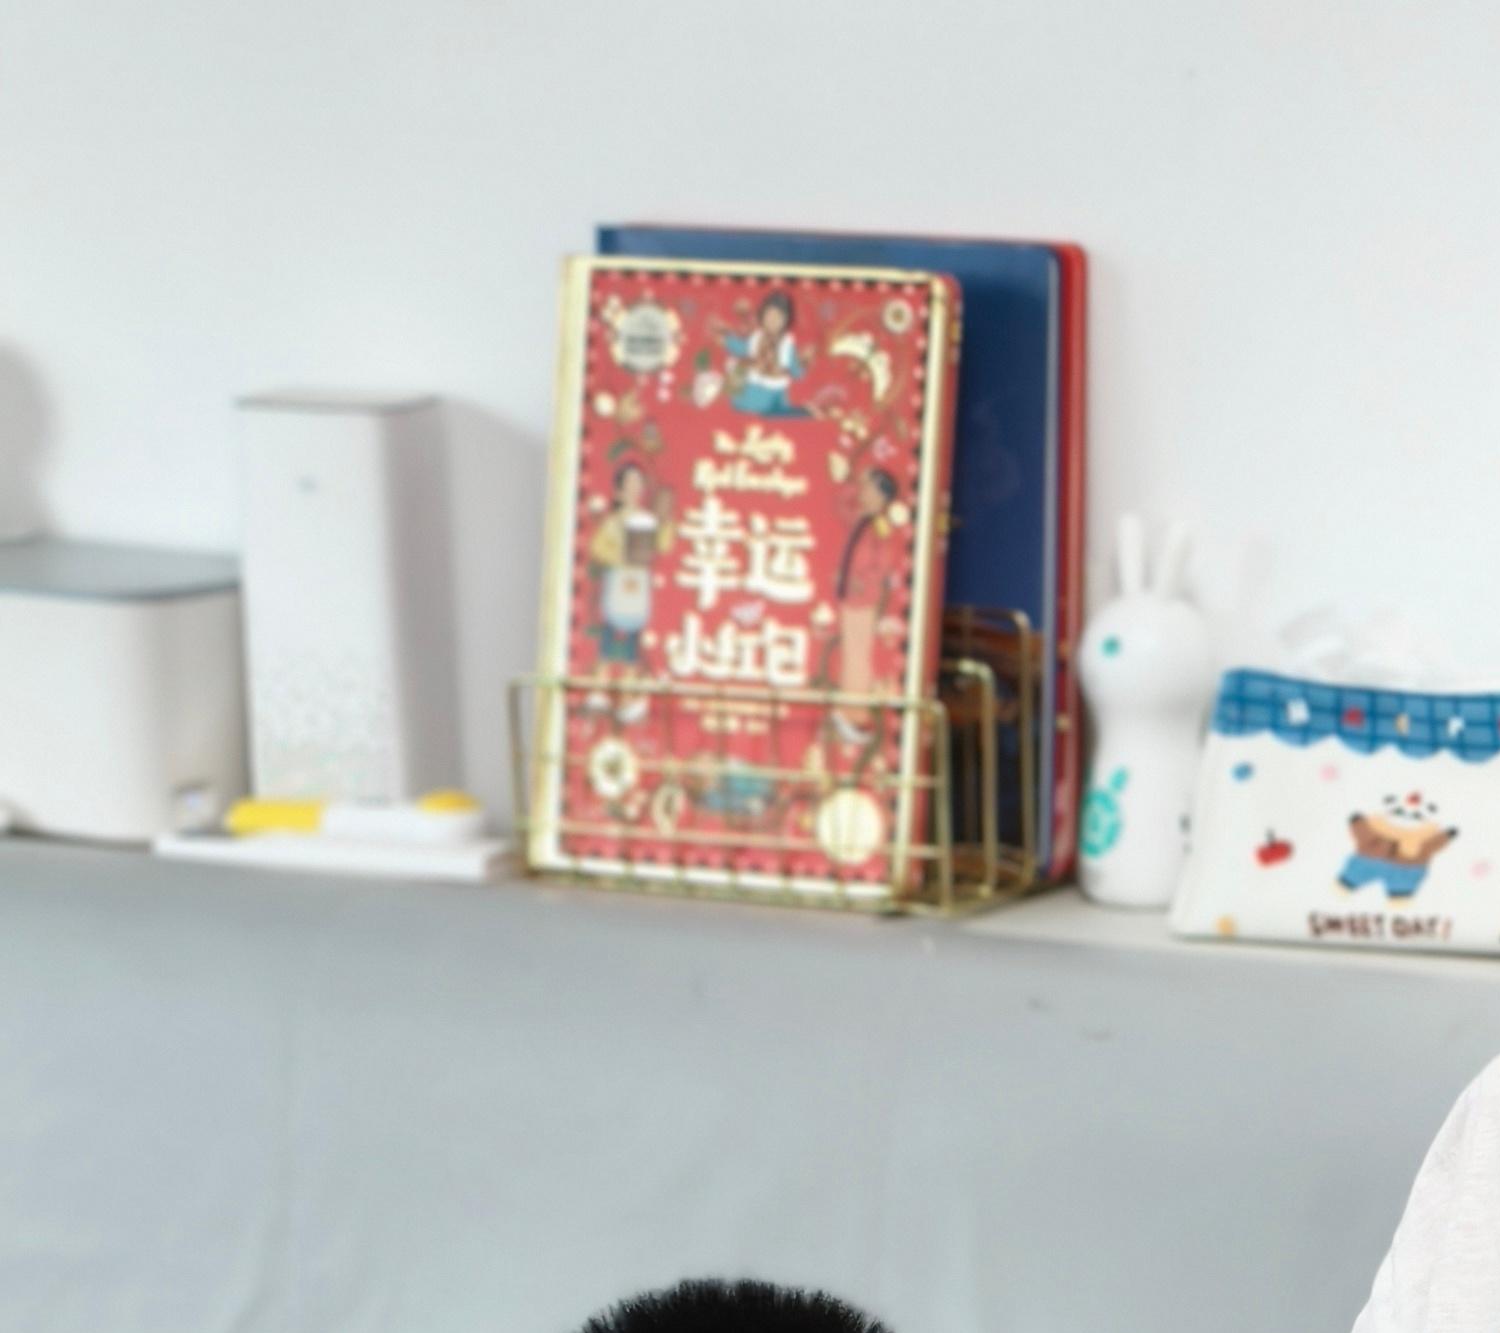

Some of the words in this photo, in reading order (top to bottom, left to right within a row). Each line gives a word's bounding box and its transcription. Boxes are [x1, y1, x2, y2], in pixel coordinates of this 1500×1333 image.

[675, 496, 815, 611] 幸运
[665, 614, 808, 687] 小红包
